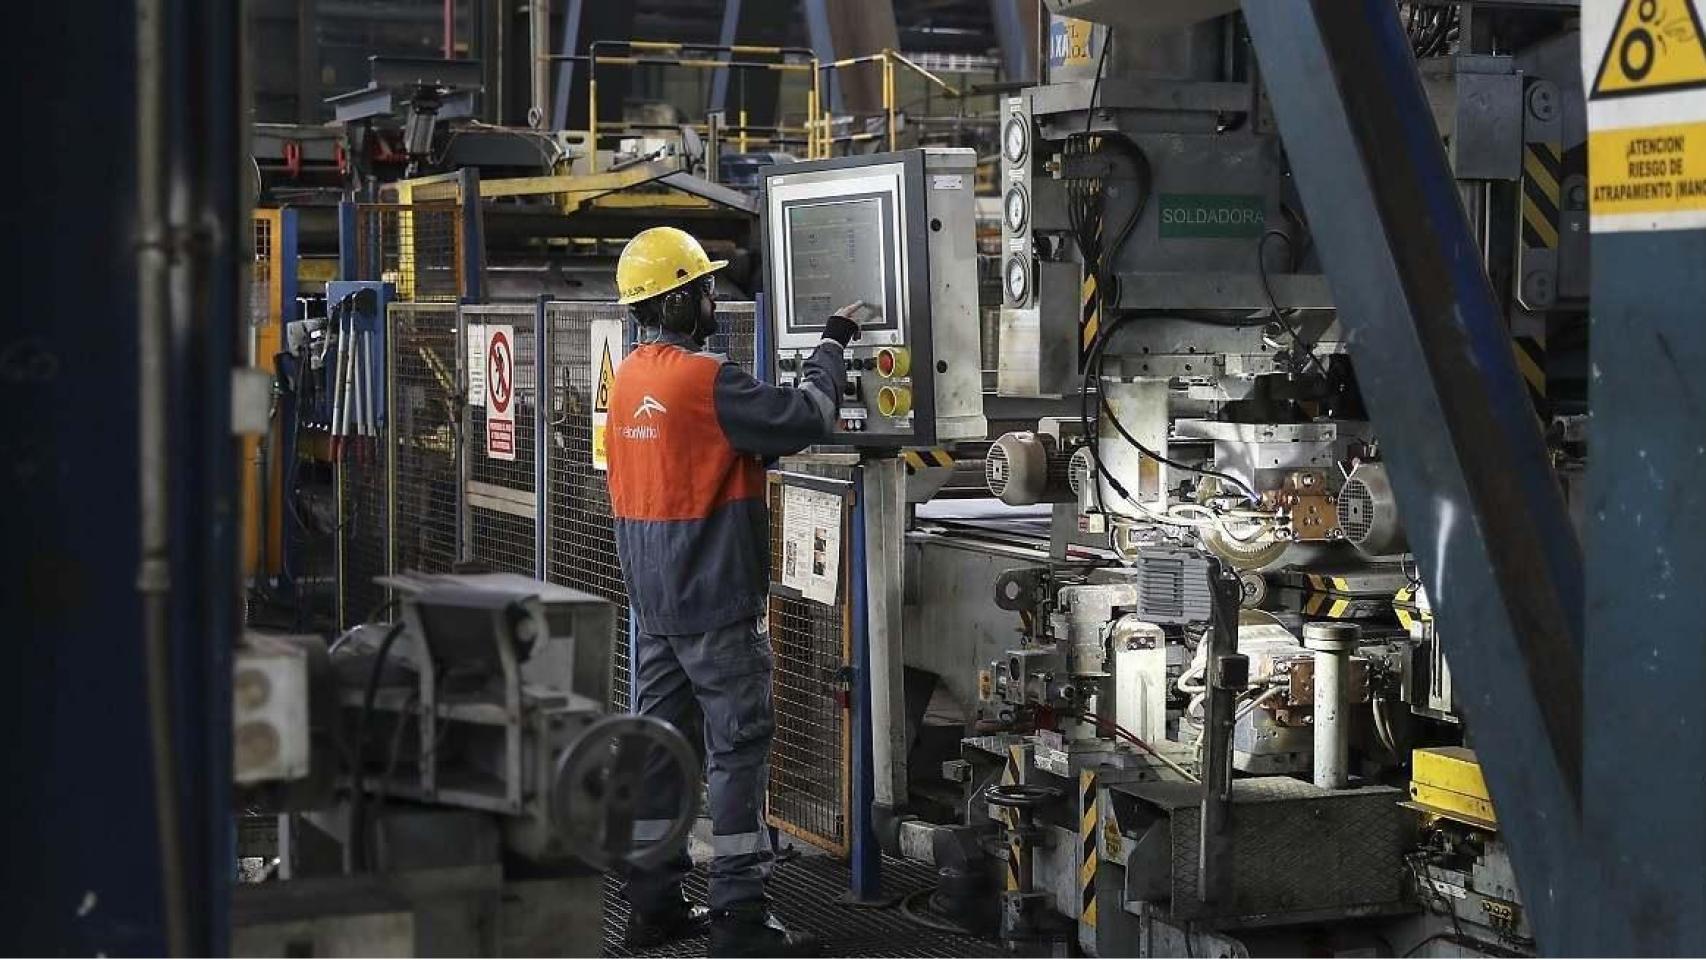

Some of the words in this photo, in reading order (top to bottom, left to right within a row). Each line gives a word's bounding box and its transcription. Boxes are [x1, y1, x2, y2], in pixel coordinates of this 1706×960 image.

[1629, 161, 1667, 177] RIESGO
[1670, 159, 1683, 175] DE
[1594, 182, 1673, 201] ATRAPAMIENTO
[1161, 207, 1265, 225] SOLDADORA
